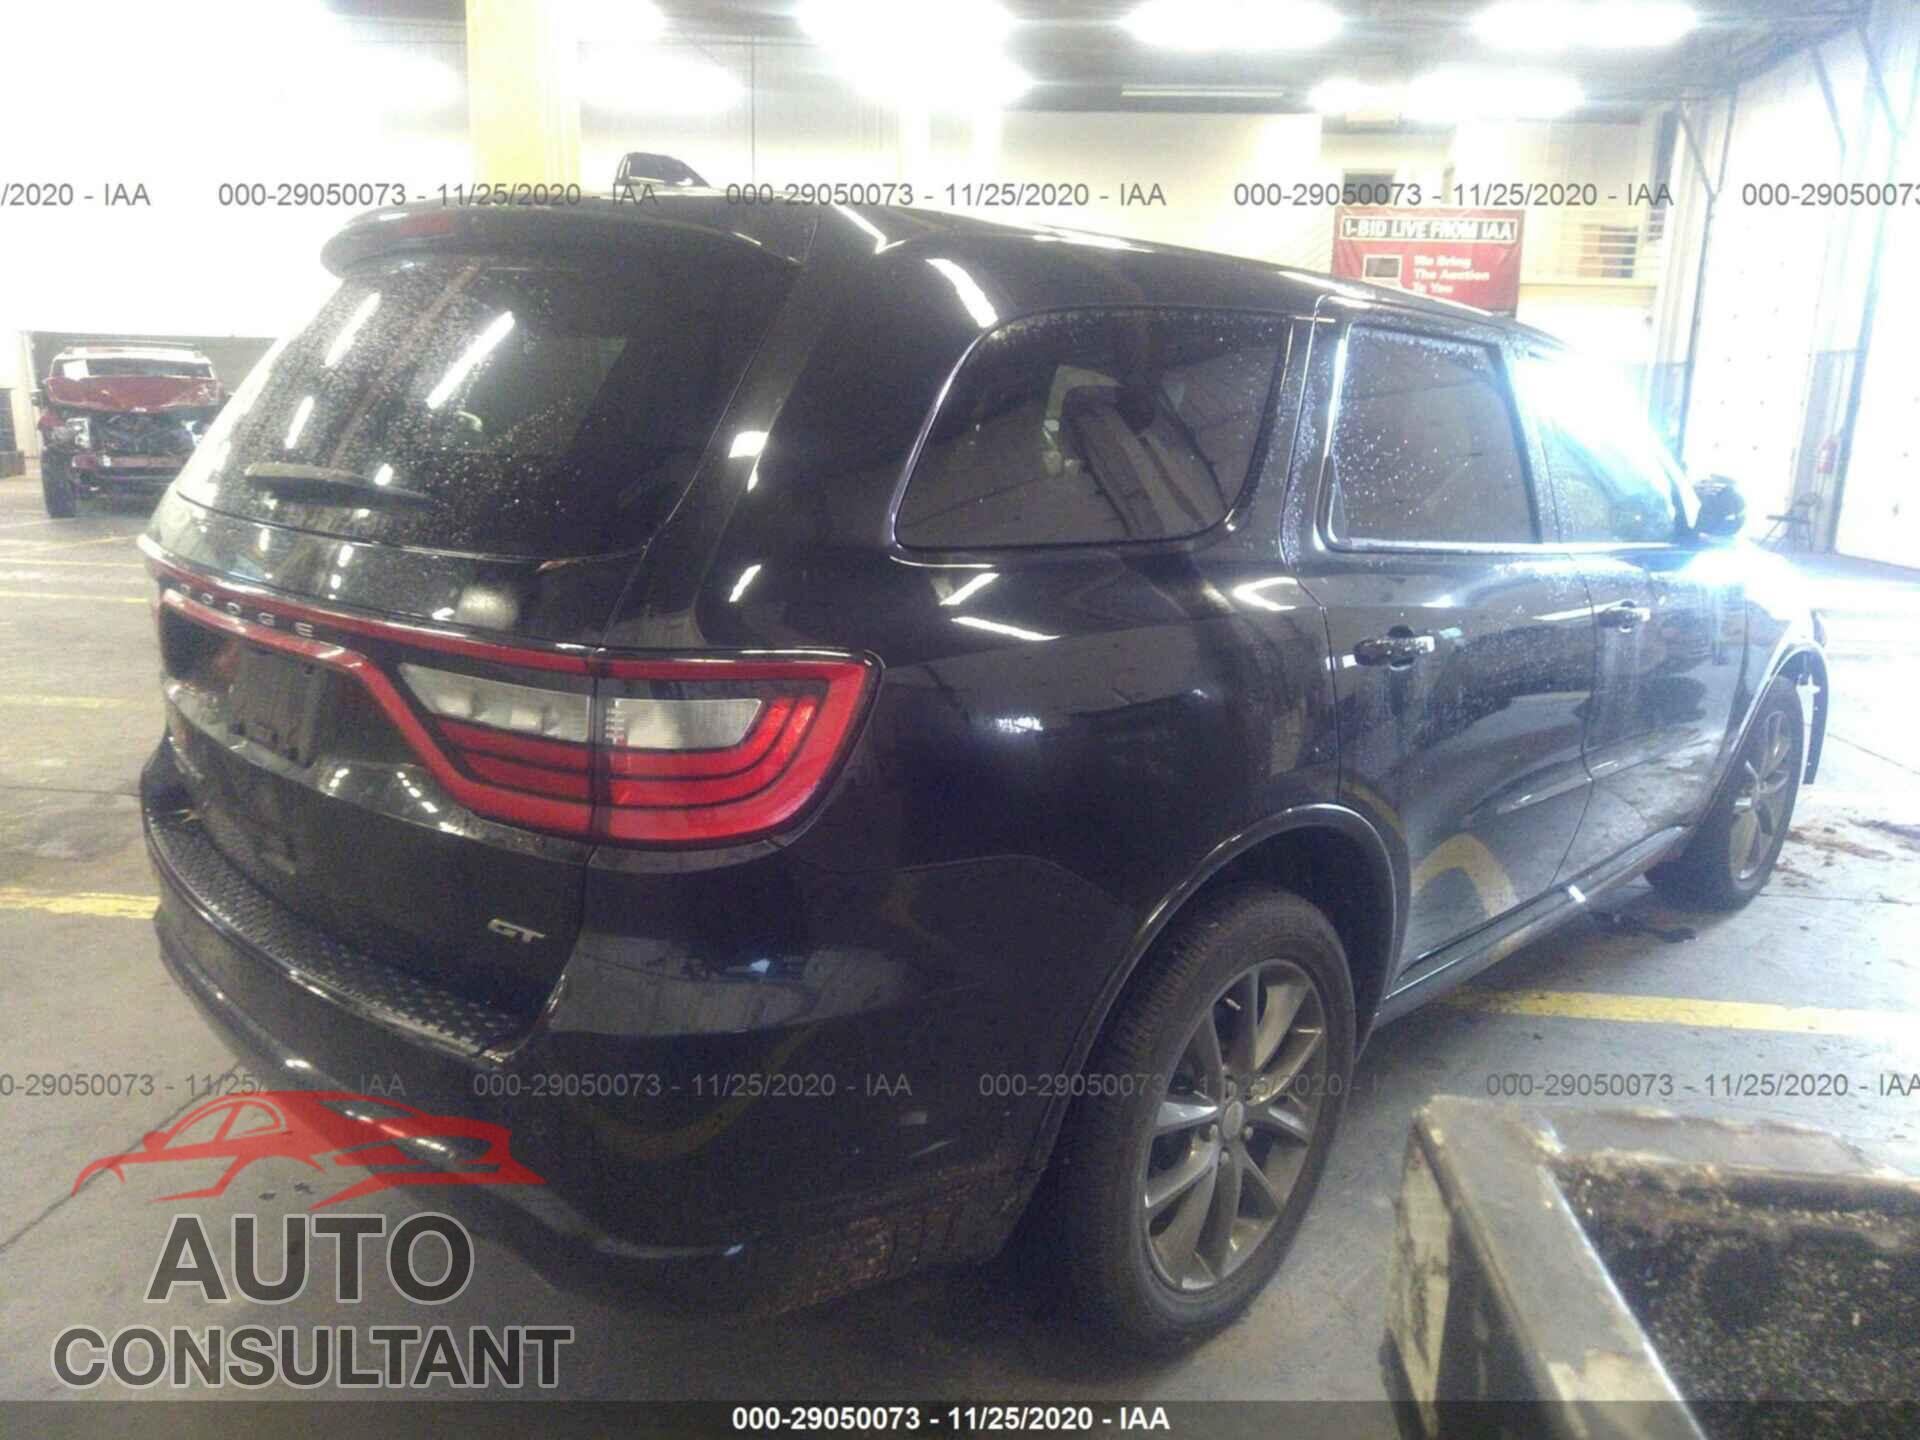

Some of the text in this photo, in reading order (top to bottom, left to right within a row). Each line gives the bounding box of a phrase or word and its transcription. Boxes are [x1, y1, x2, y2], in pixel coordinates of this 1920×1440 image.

[1391, 219, 1426, 238] LIVE
[1430, 221, 1478, 239] FROM
[1482, 221, 1512, 240] IAA
[487, 918, 546, 943] GT
